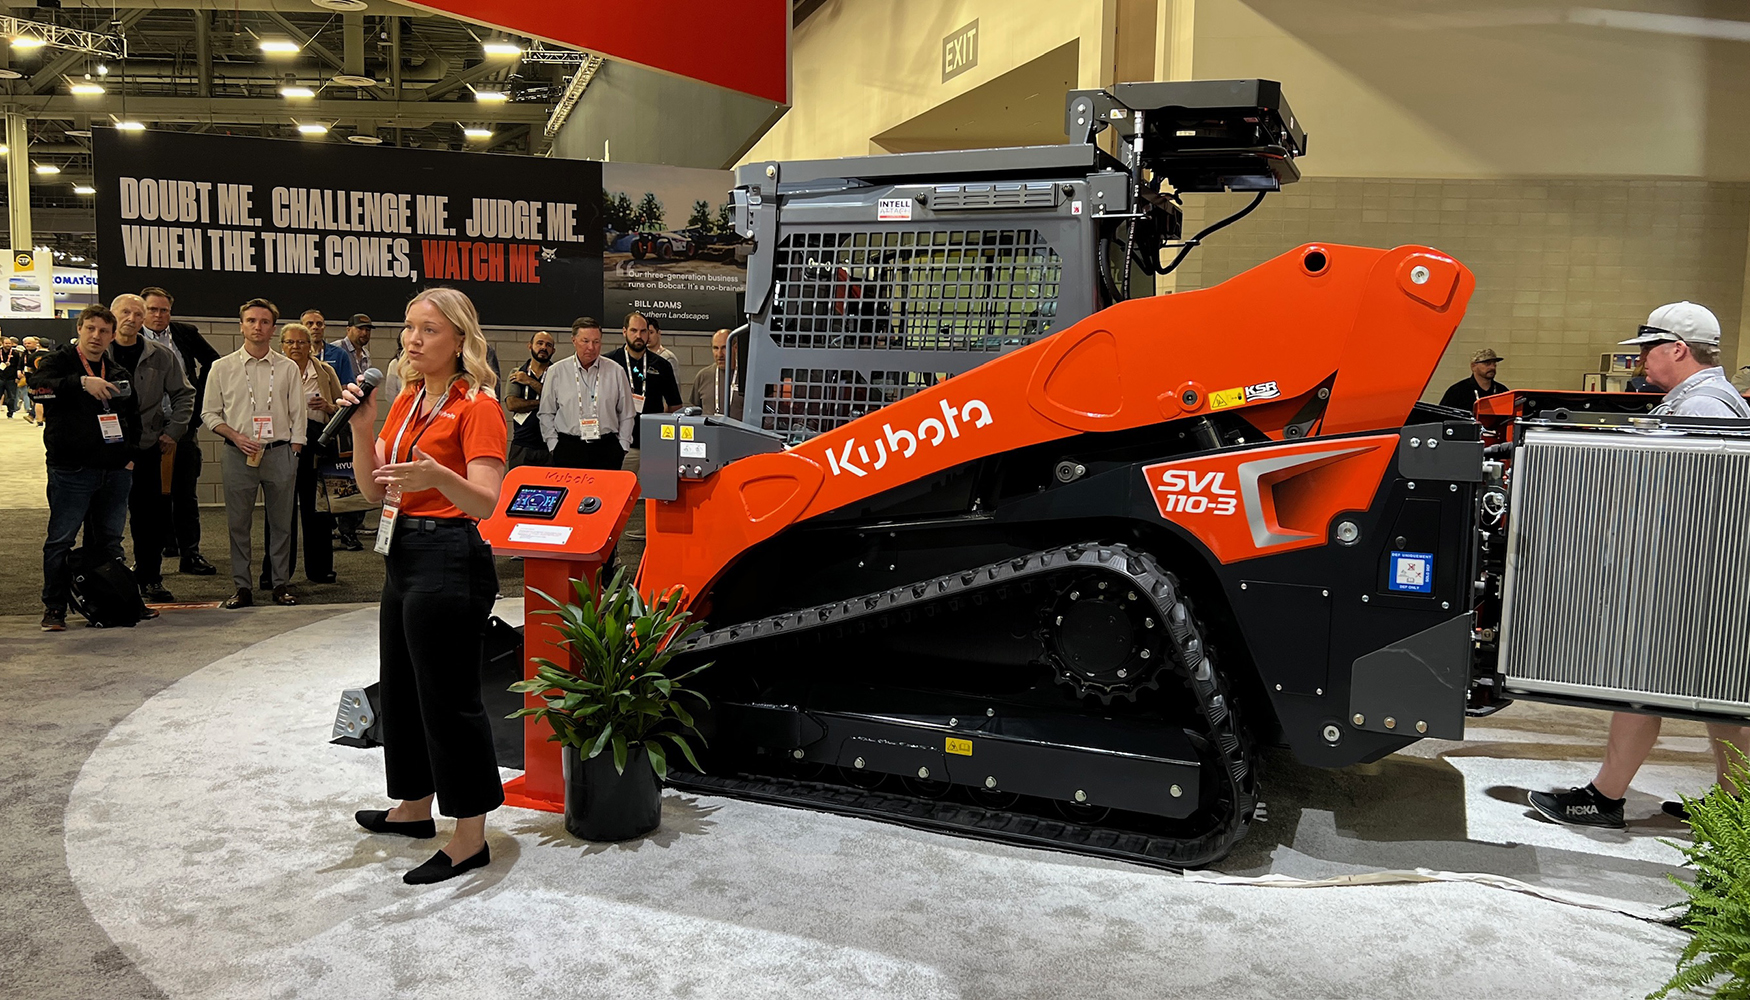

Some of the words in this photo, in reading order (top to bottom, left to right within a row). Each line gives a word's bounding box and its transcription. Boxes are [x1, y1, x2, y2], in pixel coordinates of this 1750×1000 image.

[945, 27, 977, 74] EXIT
[119, 177, 212, 223] DOUBT
[217, 183, 262, 227] ME.
[271, 186, 412, 234] CHALLENGE
[416, 194, 457, 236] ME.
[465, 198, 543, 240] JUDGE
[547, 202, 585, 243] ME.
[880, 200, 910, 208] INTELL
[121, 224, 203, 270] WHEN
[207, 229, 257, 272] THE
[261, 232, 321, 275] TIME
[325, 234, 418, 283] COMES,
[421, 239, 505, 283] WATCH
[508, 243, 541, 283] ME
[52, 275, 99, 285] OMATSU
[628, 270, 643, 278] Our
[644, 271, 707, 281] three-generation
[707, 273, 739, 283] business
[658, 281, 686, 290] Bobcat.
[634, 300, 652, 308] BILL
[653, 300, 682, 309] ADAMS
[668, 311, 710, 321] Landscapes
[1245, 381, 1279, 396] KSR
[825, 399, 993, 478] Kubota
[545, 471, 595, 485] Kubota
[1157, 469, 1237, 496] SVL
[1165, 494, 1238, 516] 110-3
[1566, 805, 1599, 815] HOKA
